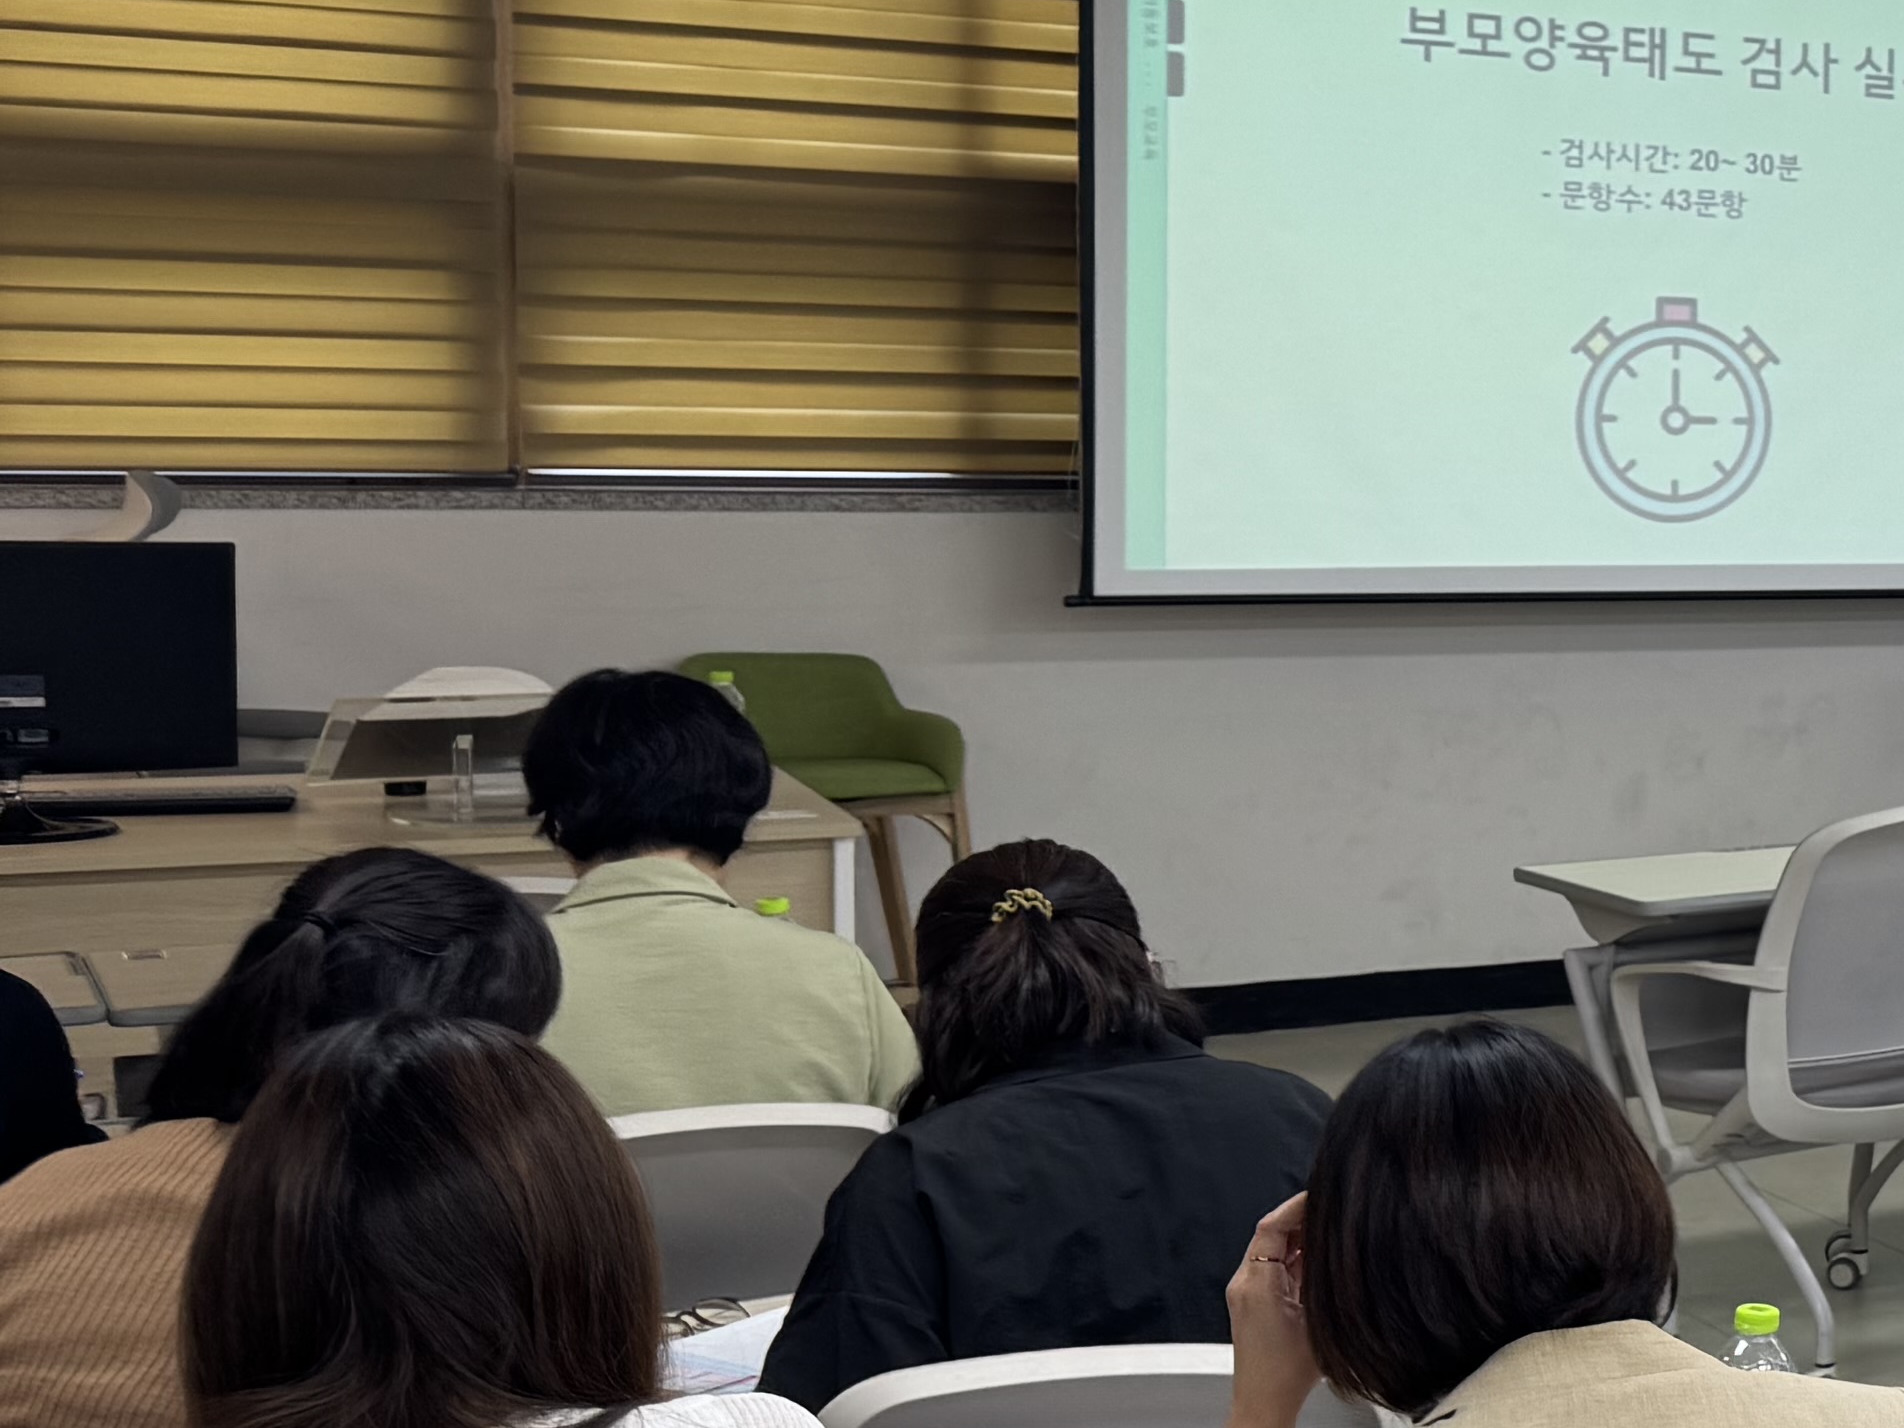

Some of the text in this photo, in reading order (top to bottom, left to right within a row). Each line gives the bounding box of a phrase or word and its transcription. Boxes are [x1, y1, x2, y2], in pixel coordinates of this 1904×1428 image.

[1400, 6, 1723, 81] 부모양육태도
[1741, 36, 1839, 95] 검사
[1559, 138, 1680, 174] 검사시간:
[1744, 153, 1803, 183] 30분
[1559, 181, 1749, 221] 문항수: 43문항
